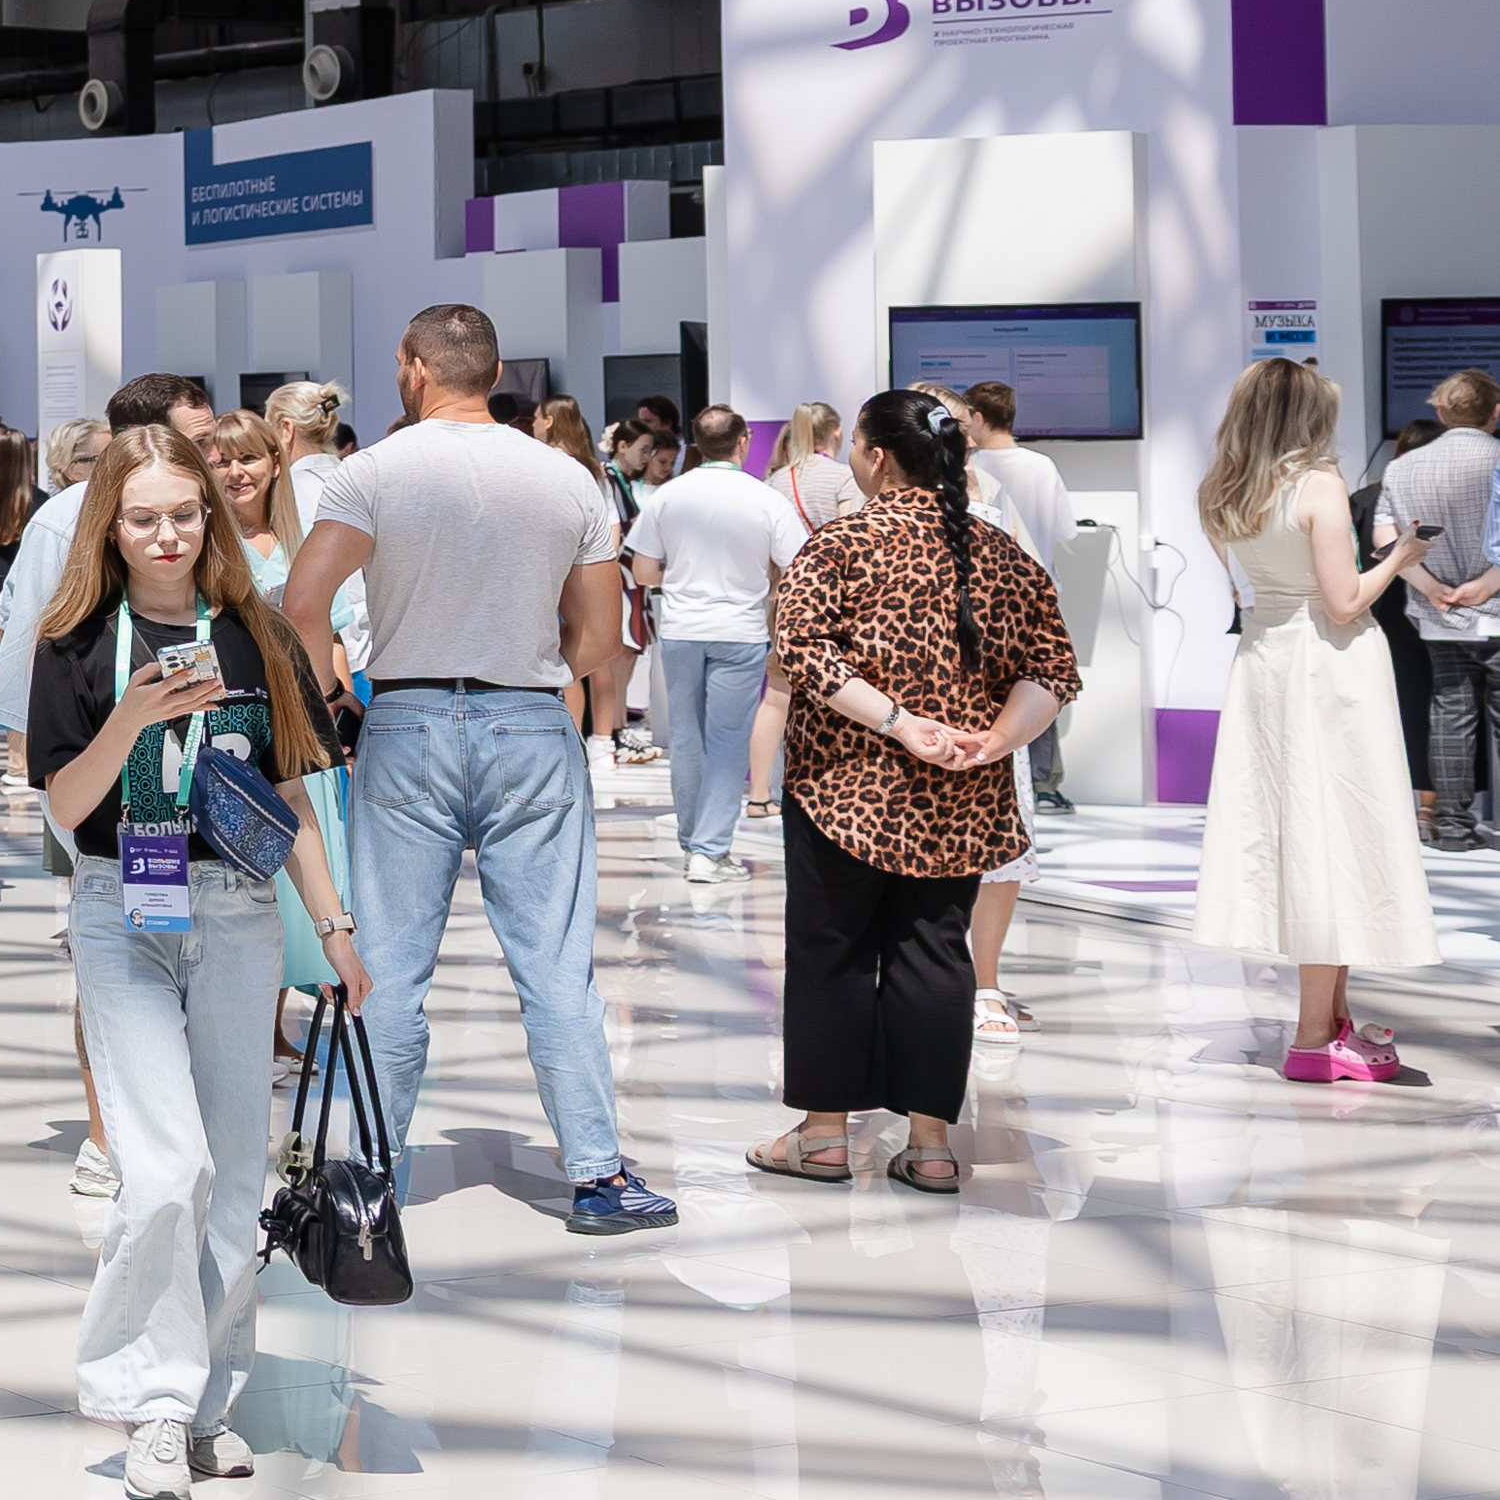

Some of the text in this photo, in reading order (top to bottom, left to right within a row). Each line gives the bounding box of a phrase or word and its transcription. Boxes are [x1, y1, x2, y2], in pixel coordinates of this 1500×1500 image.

[191, 175, 276, 204] БЕСПИЛОТНЫЕ
[191, 189, 363, 226] И ЛОГИСТИЧЕСКИЕ СИСТЕМЫ
[1255, 315, 1315, 328] МУЗЫКА
